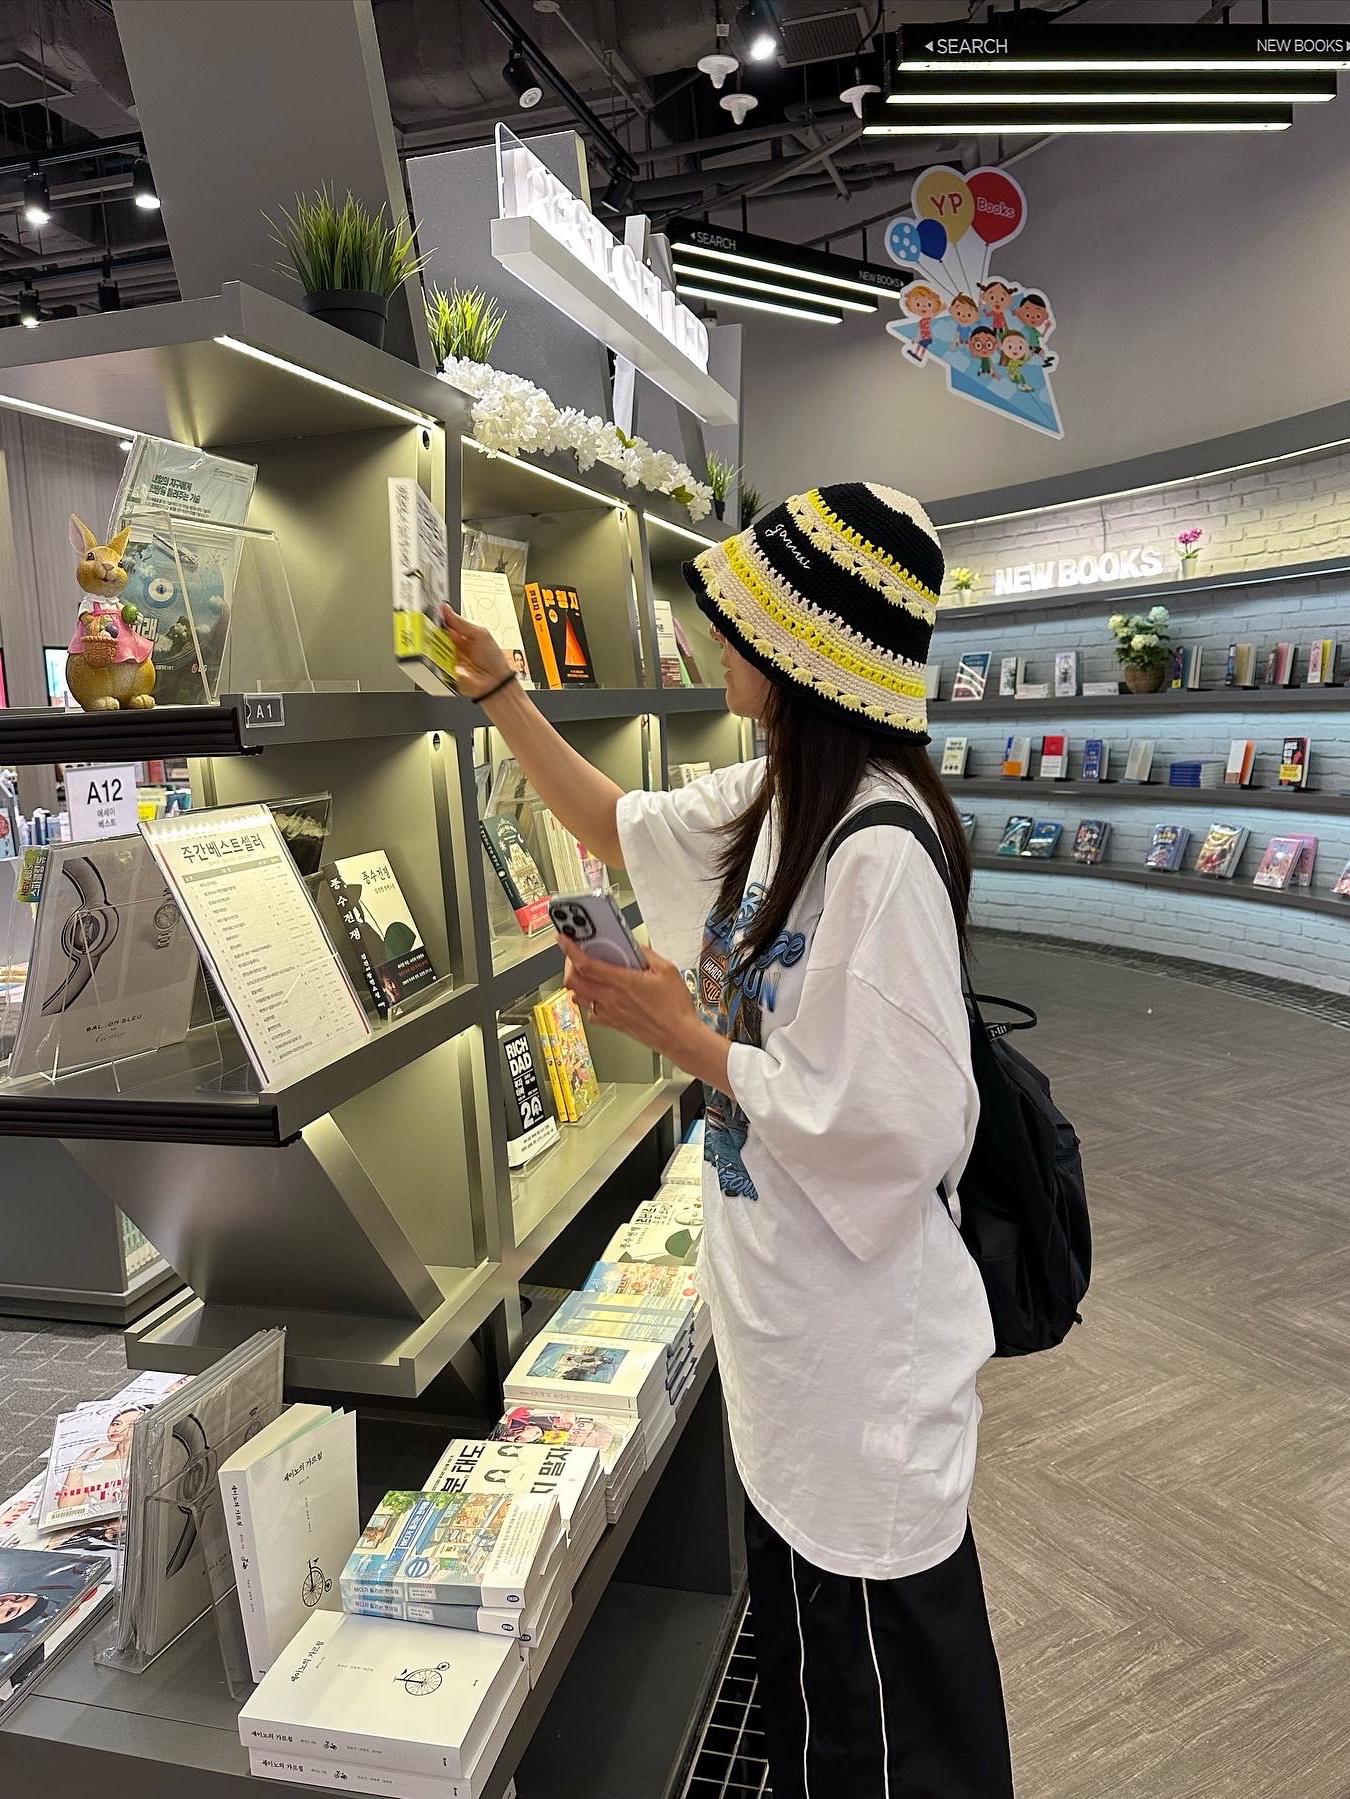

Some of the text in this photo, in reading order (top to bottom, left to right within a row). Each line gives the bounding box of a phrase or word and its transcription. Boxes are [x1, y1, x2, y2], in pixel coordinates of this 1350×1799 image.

[937, 38, 1008, 54] SEARCH
[1257, 38, 1344, 53] NEW BOOKS
[930, 192, 963, 216] YP
[978, 197, 1015, 219] Books
[697, 231, 736, 250] SEARCH
[859, 270, 901, 287] NEW BOOKS
[995, 546, 1163, 595] NEW BOOKS
[87, 778, 123, 804] A12
[97, 808, 116, 818] 에세이
[98, 818, 117, 828] 베스트
[181, 834, 265, 863] 주간베스트셀러
[361, 866, 391, 885] 풍수전쟁
[330, 877, 361, 940] 풍수전쟁
[122, 1014, 142, 1023] BLEU
[505, 1036, 529, 1060] RICH
[509, 1052, 533, 1077] DAD
[283, 1462, 305, 1482] 세이노의
[306, 1451, 323, 1468] 가르침
[538, 1448, 572, 1476] 말자
[231, 1485, 242, 1508] 세이노의
[385, 1604, 398, 1612] 편의점
[291, 1640, 324, 1683] 세이노의 가르침
[251, 1730, 293, 1742] 세이노의 가르침
[262, 1760, 304, 1772] 세이노의 가르침
